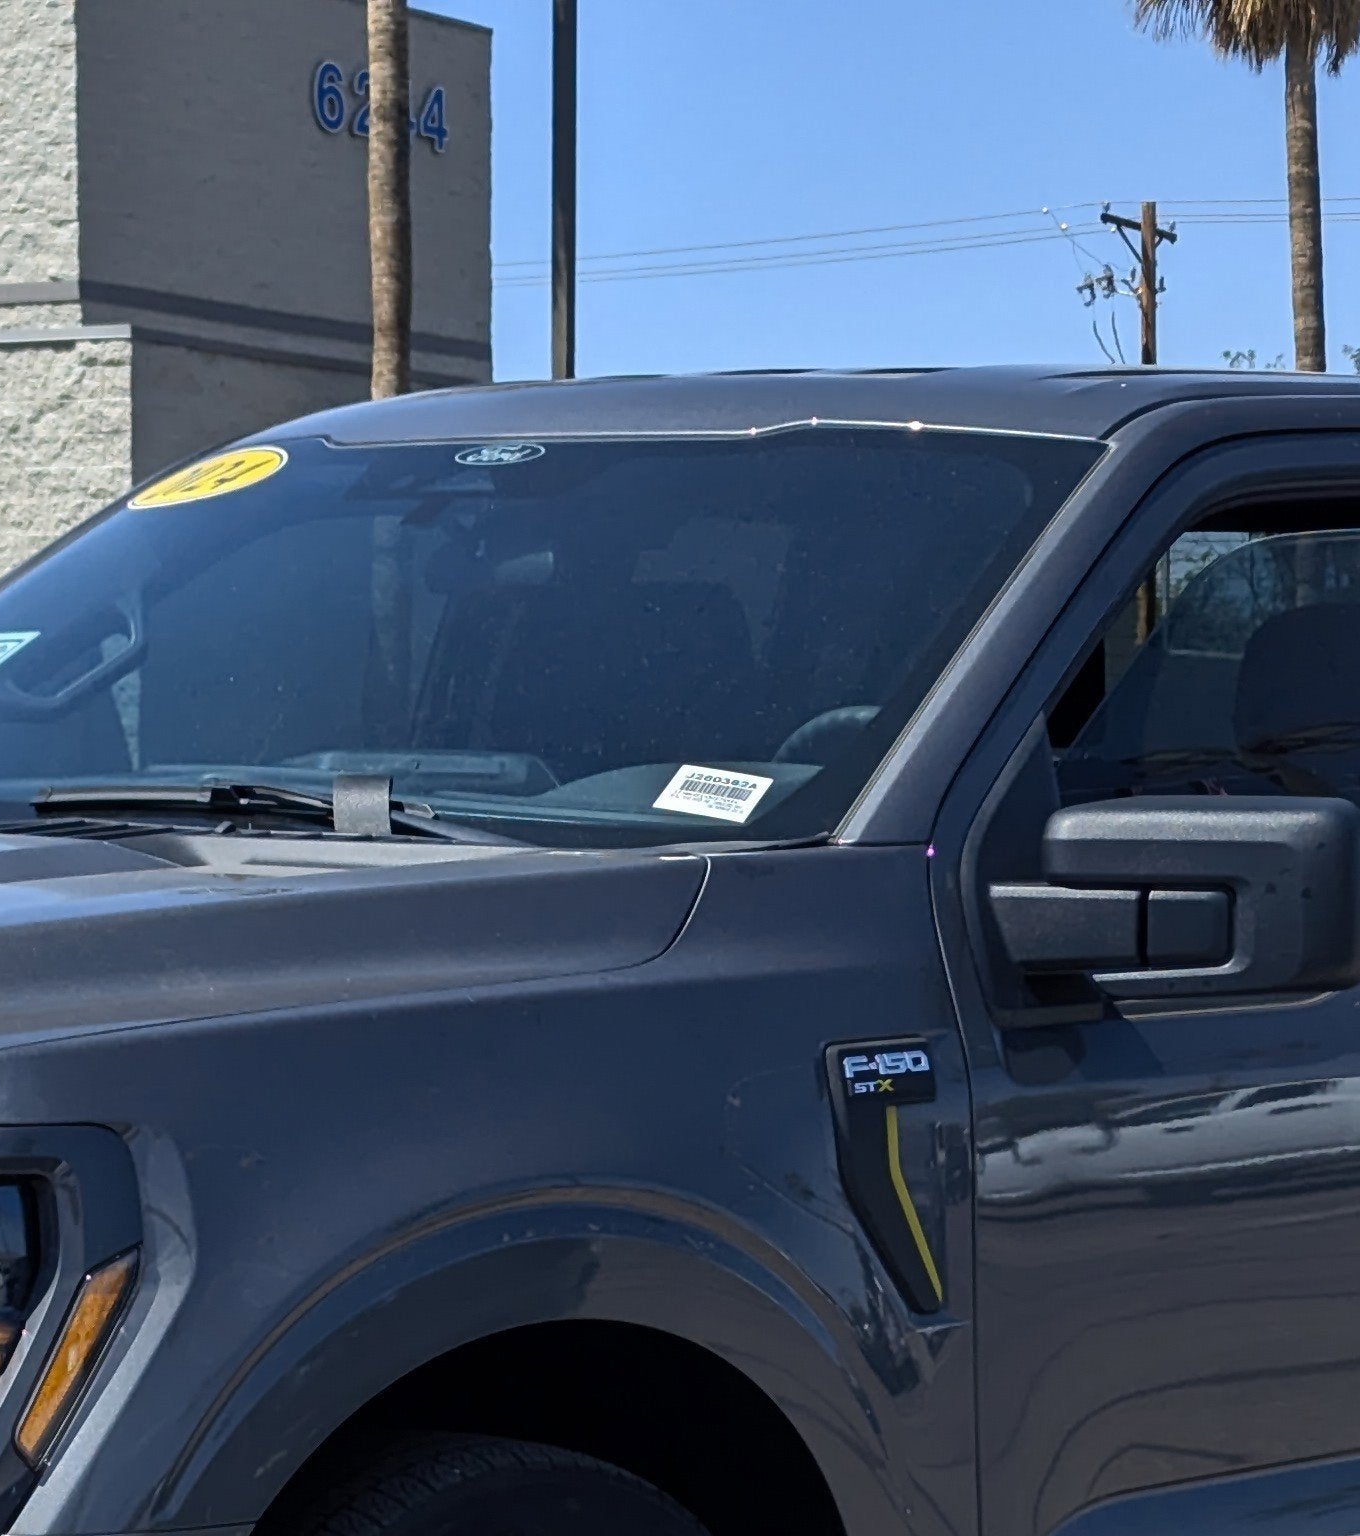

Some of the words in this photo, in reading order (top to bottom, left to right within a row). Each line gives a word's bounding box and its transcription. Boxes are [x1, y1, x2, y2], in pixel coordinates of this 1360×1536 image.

[314, 61, 450, 153] 624
[842, 1049, 930, 1079] F-150
[853, 1079, 894, 1094] STX
